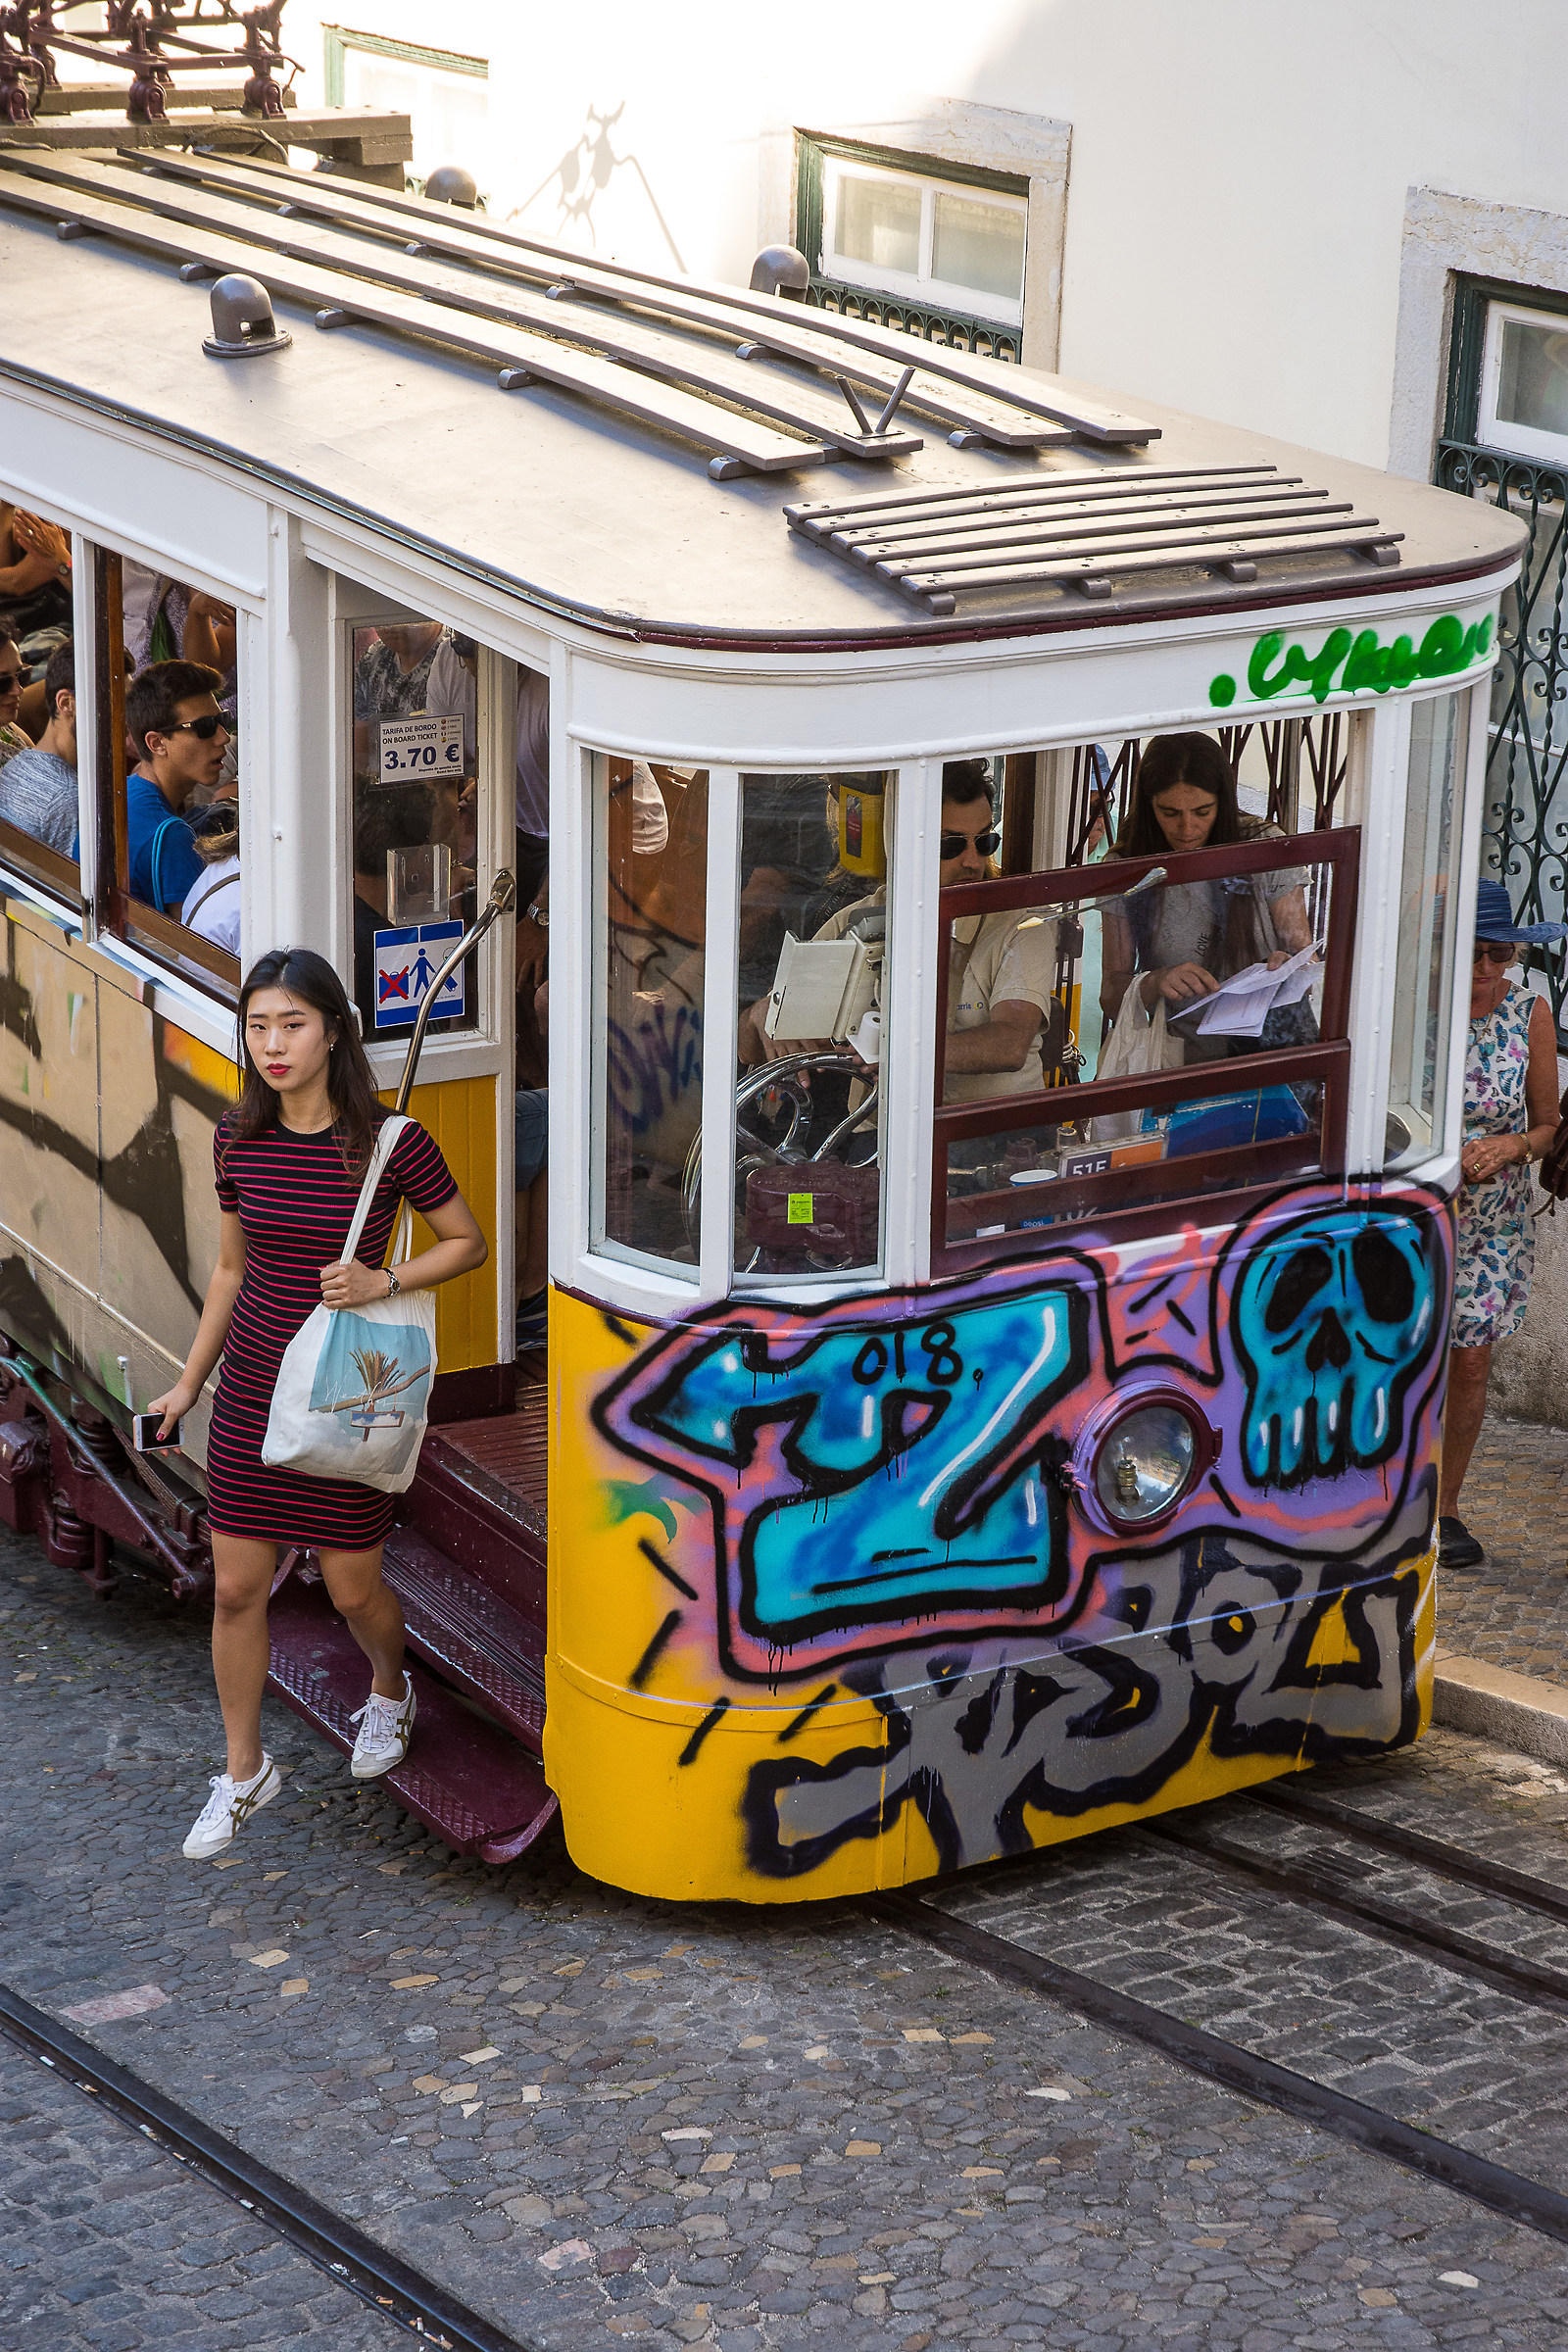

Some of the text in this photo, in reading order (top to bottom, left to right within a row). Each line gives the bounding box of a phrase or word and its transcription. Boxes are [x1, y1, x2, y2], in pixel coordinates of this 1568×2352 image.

[415, 723, 437, 732] BORDO
[394, 735, 416, 744] BOARD
[384, 743, 460, 770] 3.70 €
